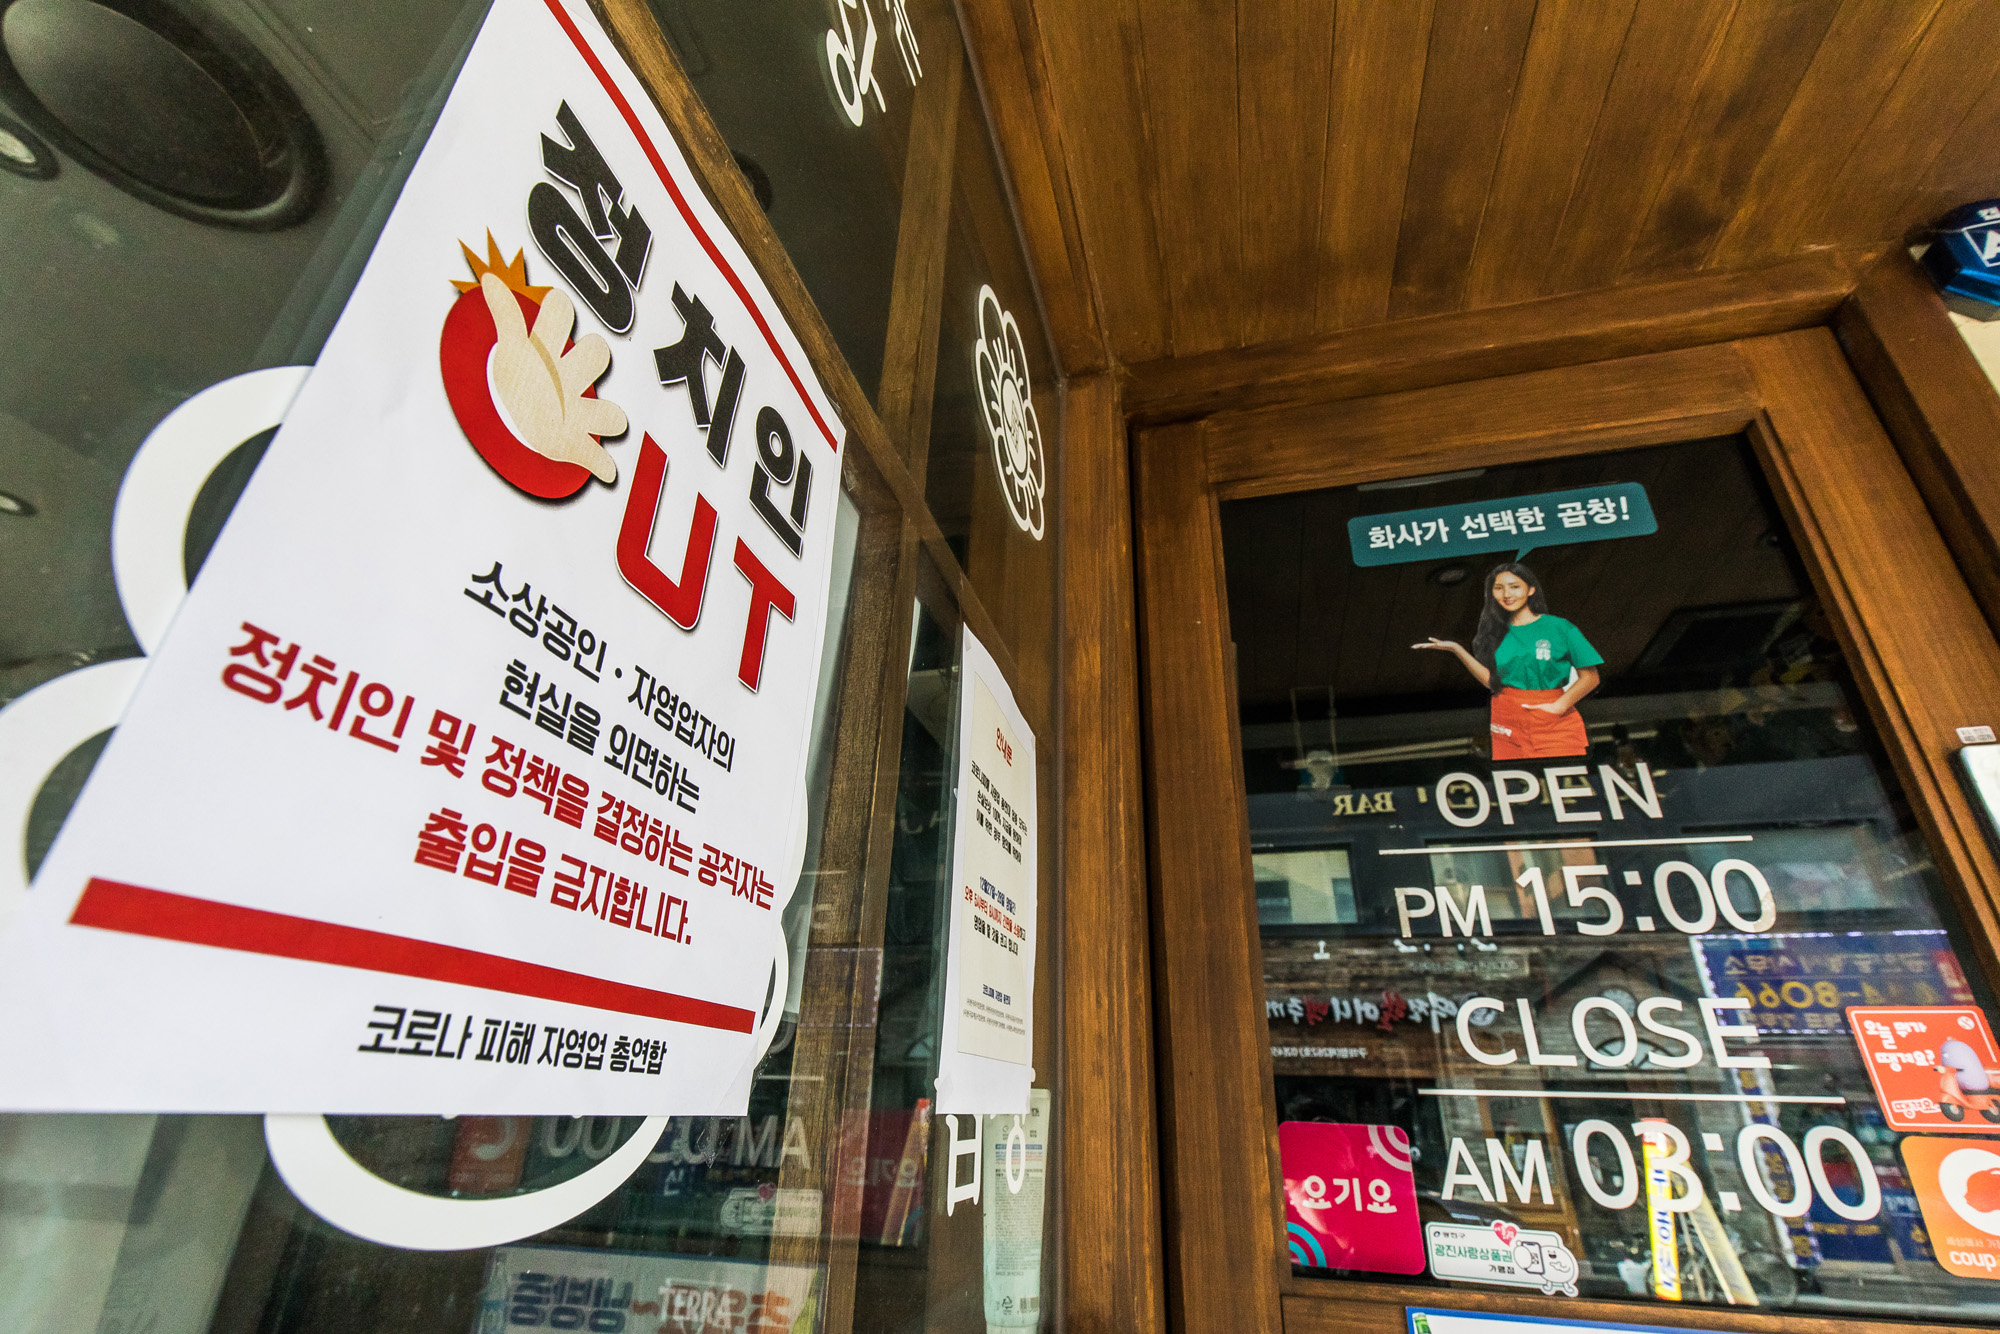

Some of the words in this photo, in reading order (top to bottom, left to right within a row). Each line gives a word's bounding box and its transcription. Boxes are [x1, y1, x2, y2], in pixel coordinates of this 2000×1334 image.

[527, 98, 813, 559] 정치인
[1369, 519, 1449, 548] 화사가
[1460, 507, 1545, 539] 선택한
[1558, 497, 1629, 527] 곱창!
[464, 562, 606, 681] 소상공인
[628, 666, 735, 772] 자영업자의
[222, 622, 414, 752] 정치인
[421, 710, 476, 778] 및
[482, 736, 589, 828] 정책을
[594, 792, 692, 876] 결정하는
[698, 844, 773, 909] 공직자는
[500, 659, 600, 755] 현실을
[604, 725, 699, 814] 외면하는
[996, 727, 1013, 767] 안내문
[1437, 763, 1662, 826] OPEN
[415, 808, 546, 897] 출입을
[551, 854, 691, 944] 금지합니다.
[965, 886, 973, 903] 오후
[1395, 885, 1492, 937] PM
[1516, 856, 1775, 935] 15:00
[974, 915, 985, 935] 영업을
[359, 1006, 472, 1059] 코로나
[476, 1019, 535, 1064] 피해
[538, 1027, 607, 1070] 자영업
[610, 1036, 667, 1074] 총연합
[1457, 991, 1772, 1072] CLOSE
[1863, 1020, 1897, 1049] 오늘
[1874, 1049, 1935, 1072] 땡겨요?
[1302, 1175, 1397, 1214] 요기요
[1442, 1138, 1554, 1204] AM
[1574, 1113, 1881, 1226] 03:00
[1435, 1244, 1513, 1263] 광진사랑상품권
[1489, 1265, 1515, 1275] 가맹점
